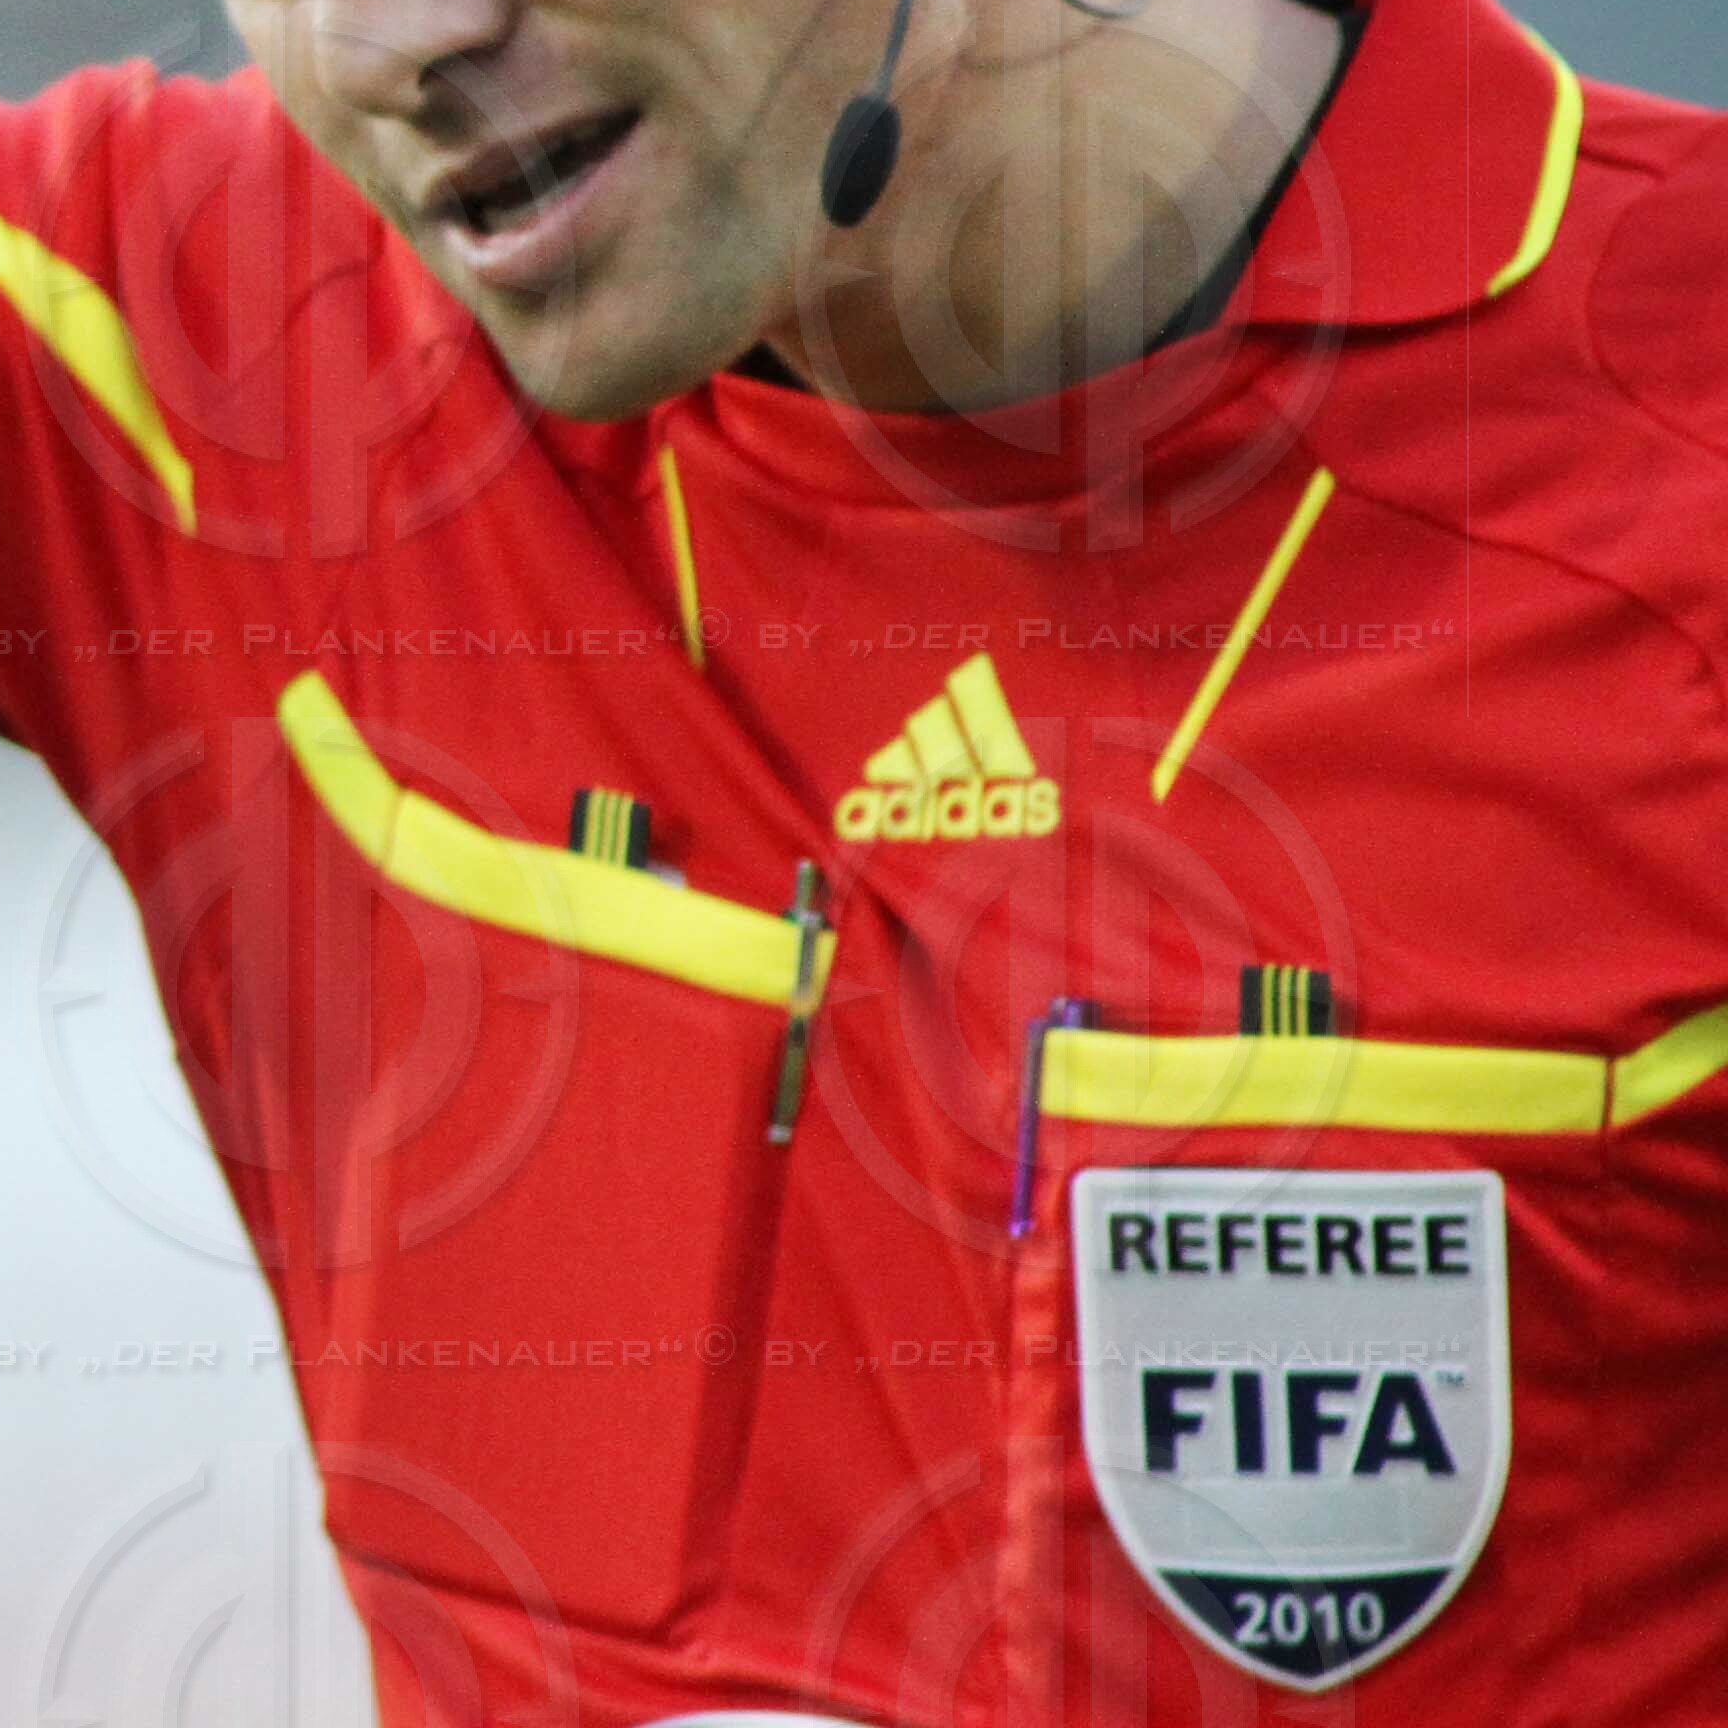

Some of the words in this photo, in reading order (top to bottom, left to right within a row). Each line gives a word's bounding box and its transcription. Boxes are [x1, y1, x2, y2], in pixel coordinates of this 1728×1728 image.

[836, 775, 1061, 842] adidas
[1109, 1214, 1470, 1278] REFEREE
[1143, 1370, 1456, 1476] FIFA
[1234, 1594, 1384, 1648] 2010
